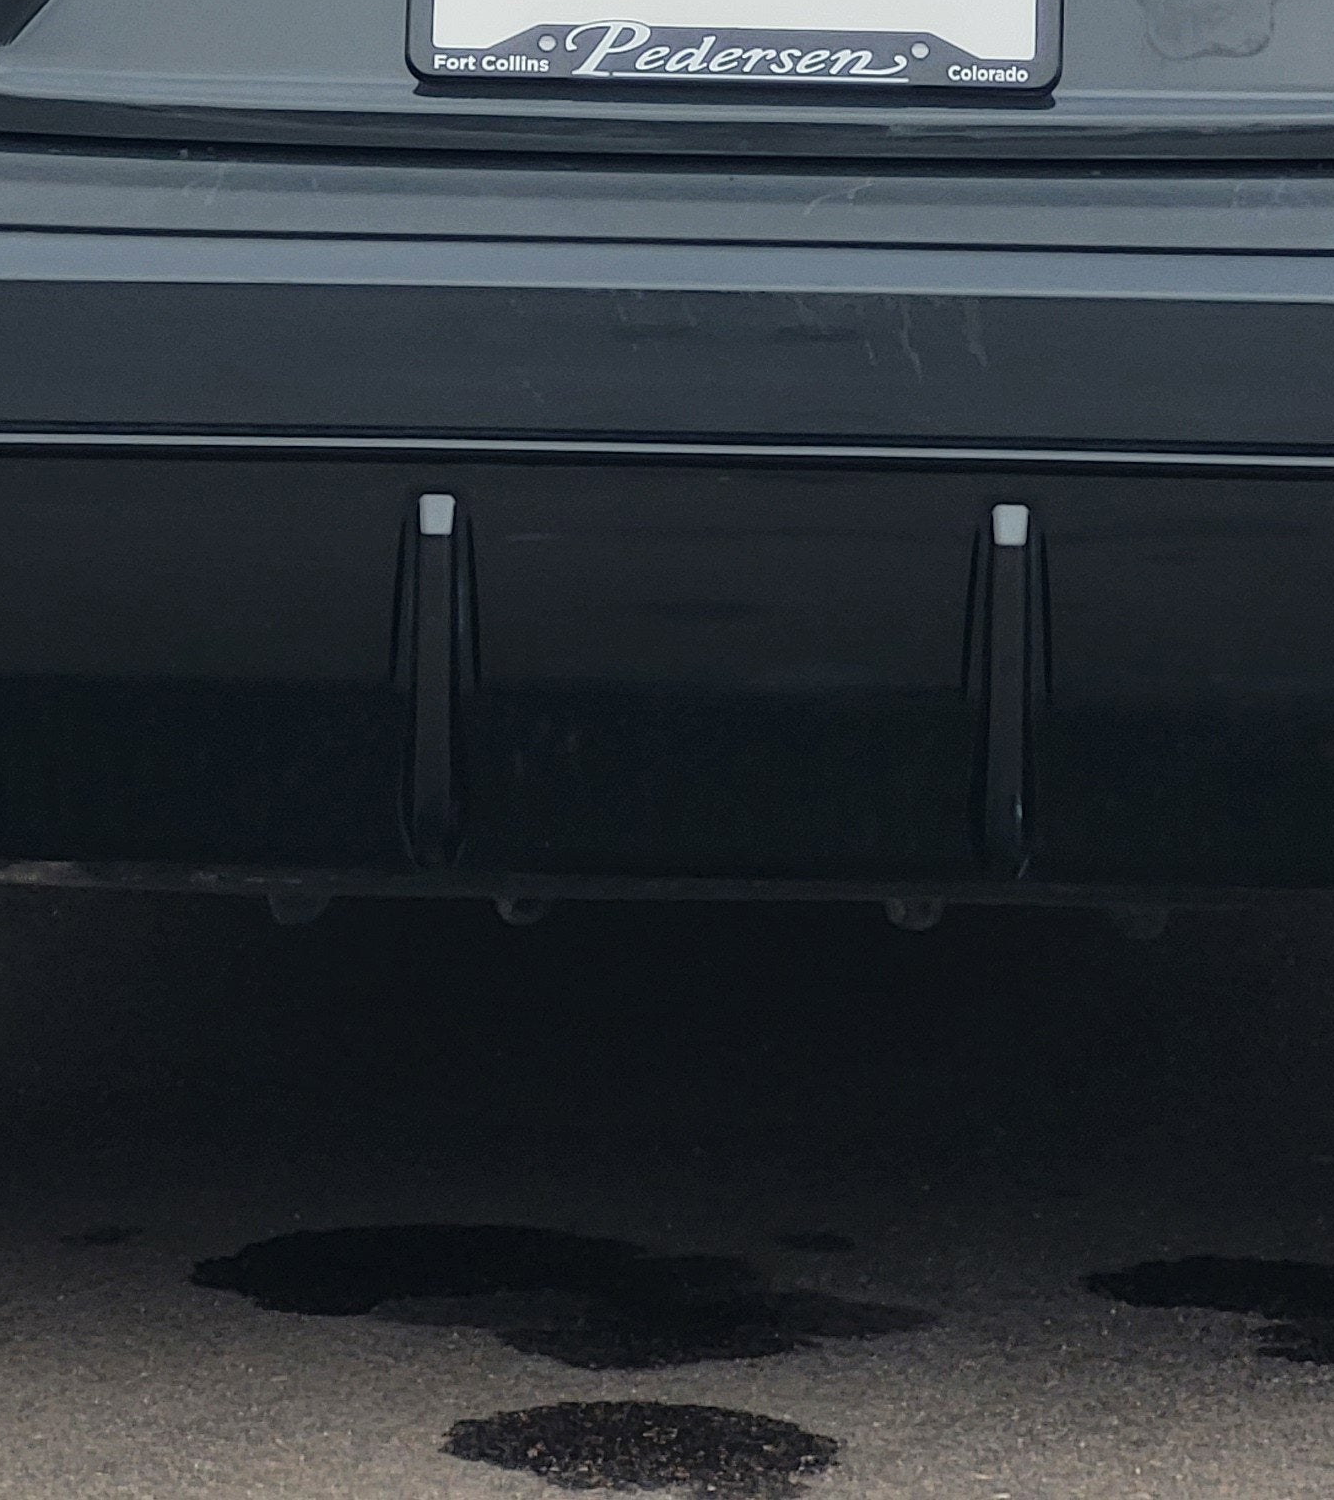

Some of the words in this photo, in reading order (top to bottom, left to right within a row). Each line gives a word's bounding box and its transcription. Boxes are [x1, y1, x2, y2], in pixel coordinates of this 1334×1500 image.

[564, 20, 909, 77] Pedersen
[433, 53, 477, 71] Fort
[481, 54, 550, 72] Collins
[947, 64, 1029, 84] Colorado
